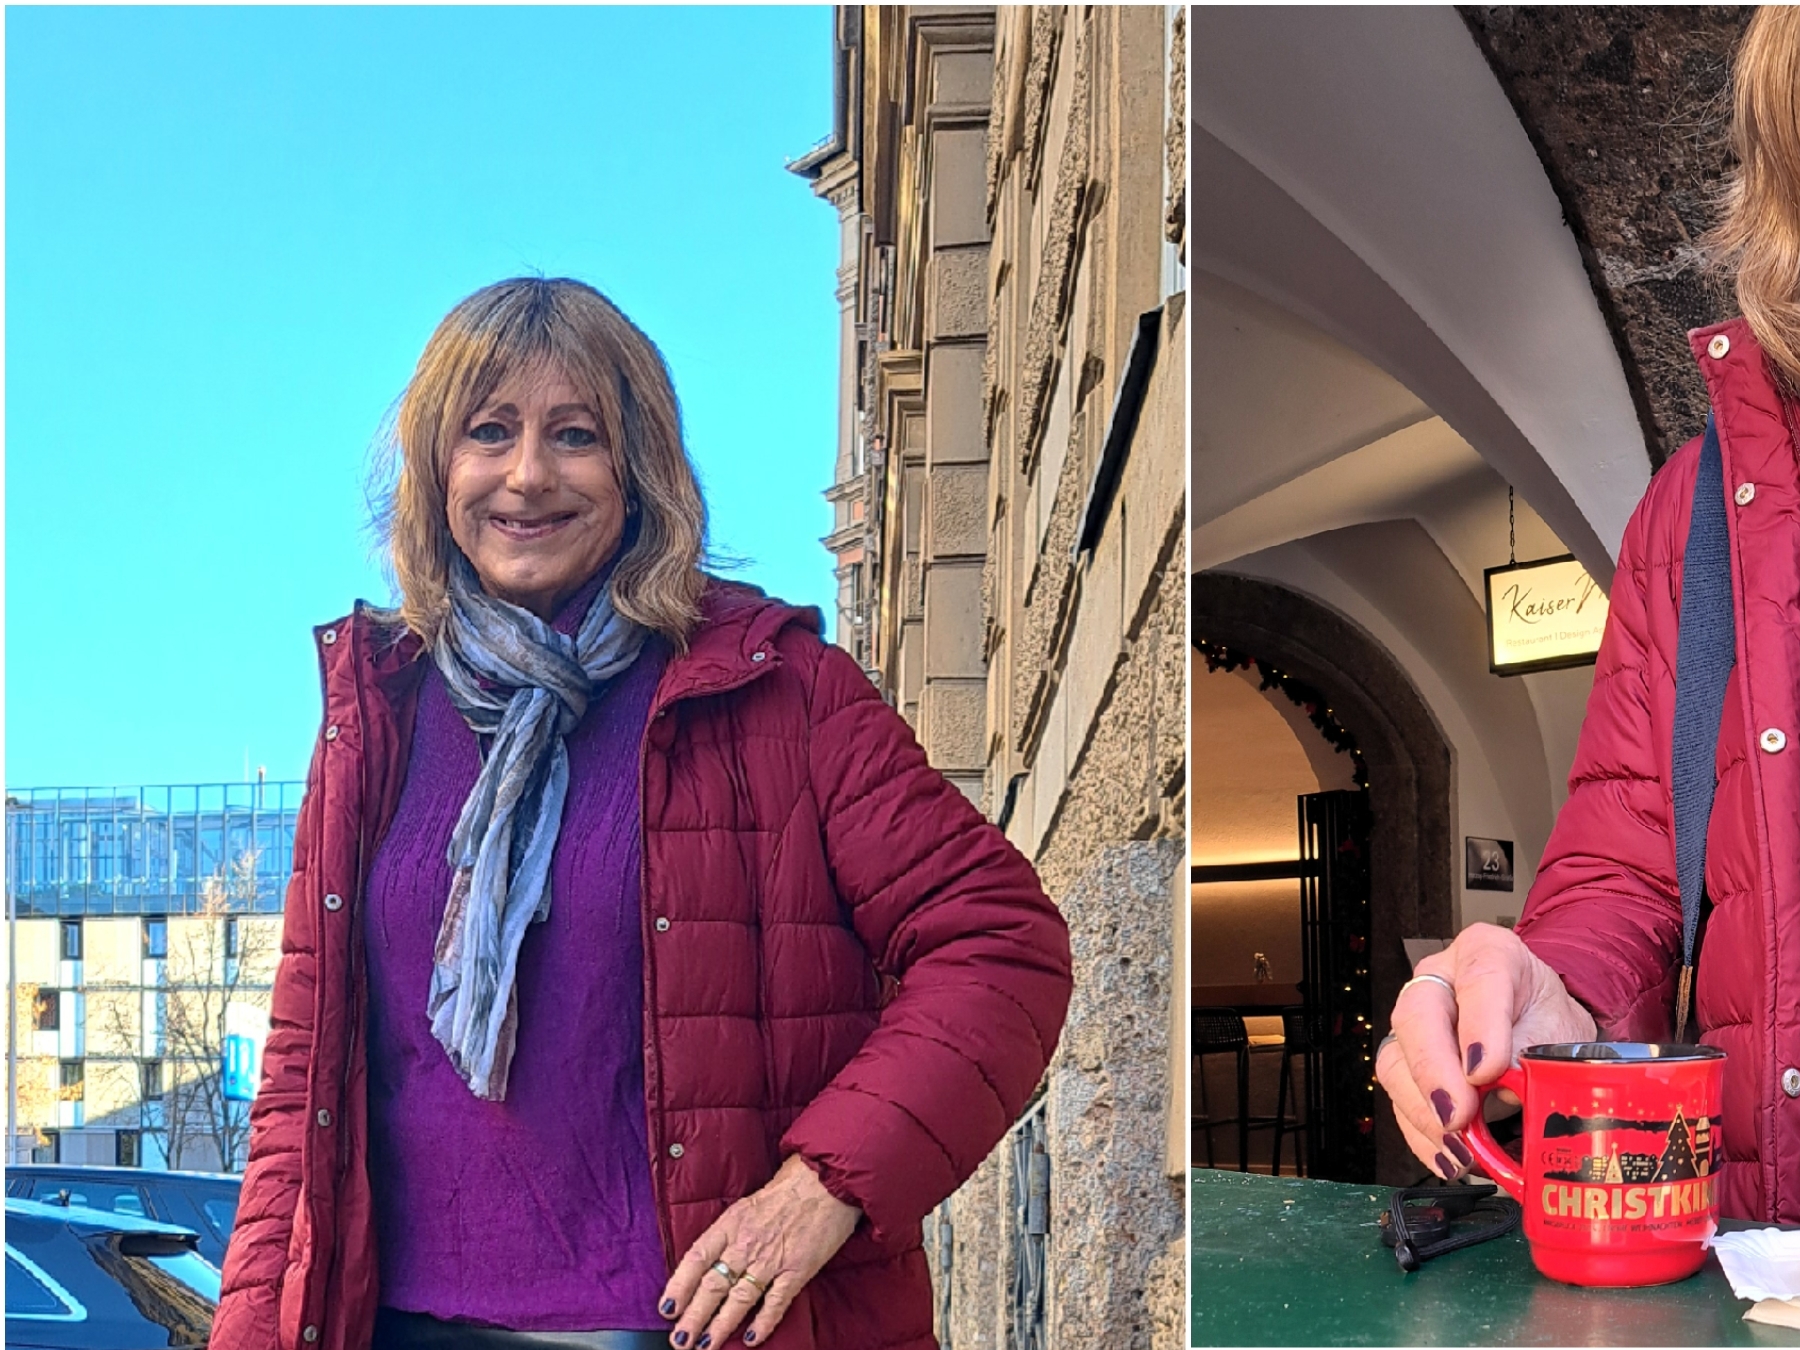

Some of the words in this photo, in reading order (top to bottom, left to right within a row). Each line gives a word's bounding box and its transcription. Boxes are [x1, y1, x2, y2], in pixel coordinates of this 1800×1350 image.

[1506, 633, 1553, 647] Restaurant
[1559, 629, 1590, 643] Design
[1483, 850, 1500, 871] 23
